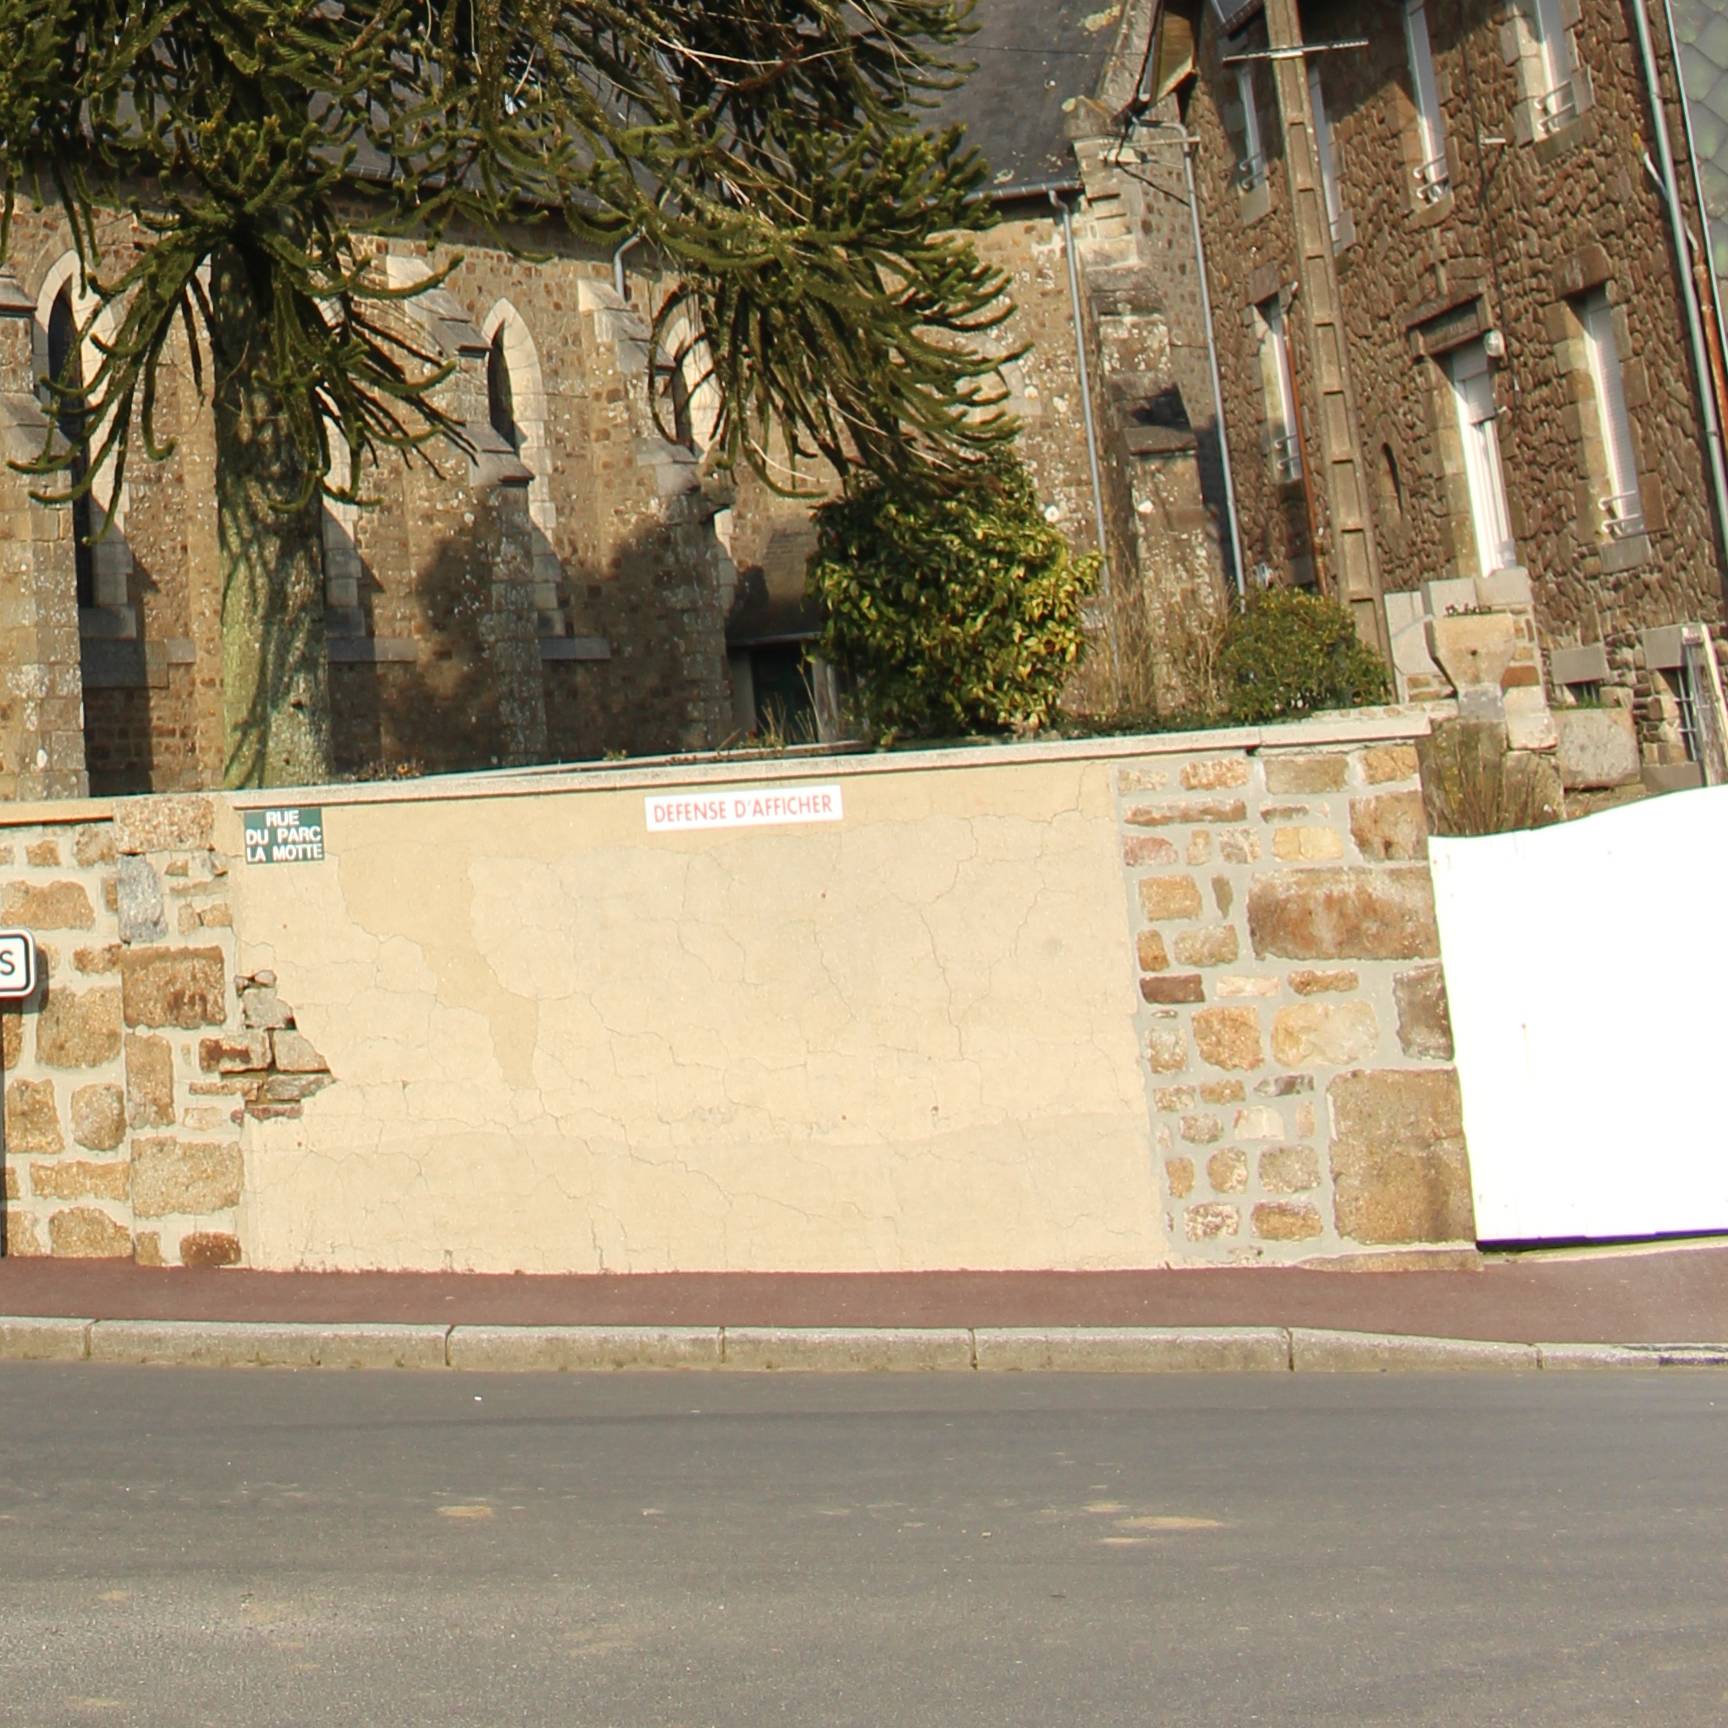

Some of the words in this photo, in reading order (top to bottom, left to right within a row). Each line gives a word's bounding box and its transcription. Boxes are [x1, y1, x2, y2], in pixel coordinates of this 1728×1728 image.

[654, 800, 727, 823] DEFENSE
[734, 794, 832, 818] D'AFFICHER
[265, 810, 299, 827] RUE
[246, 829, 269, 844] DU
[277, 826, 321, 843] PARC
[246, 847, 266, 862] LA
[273, 844, 322, 861] MOTTE
